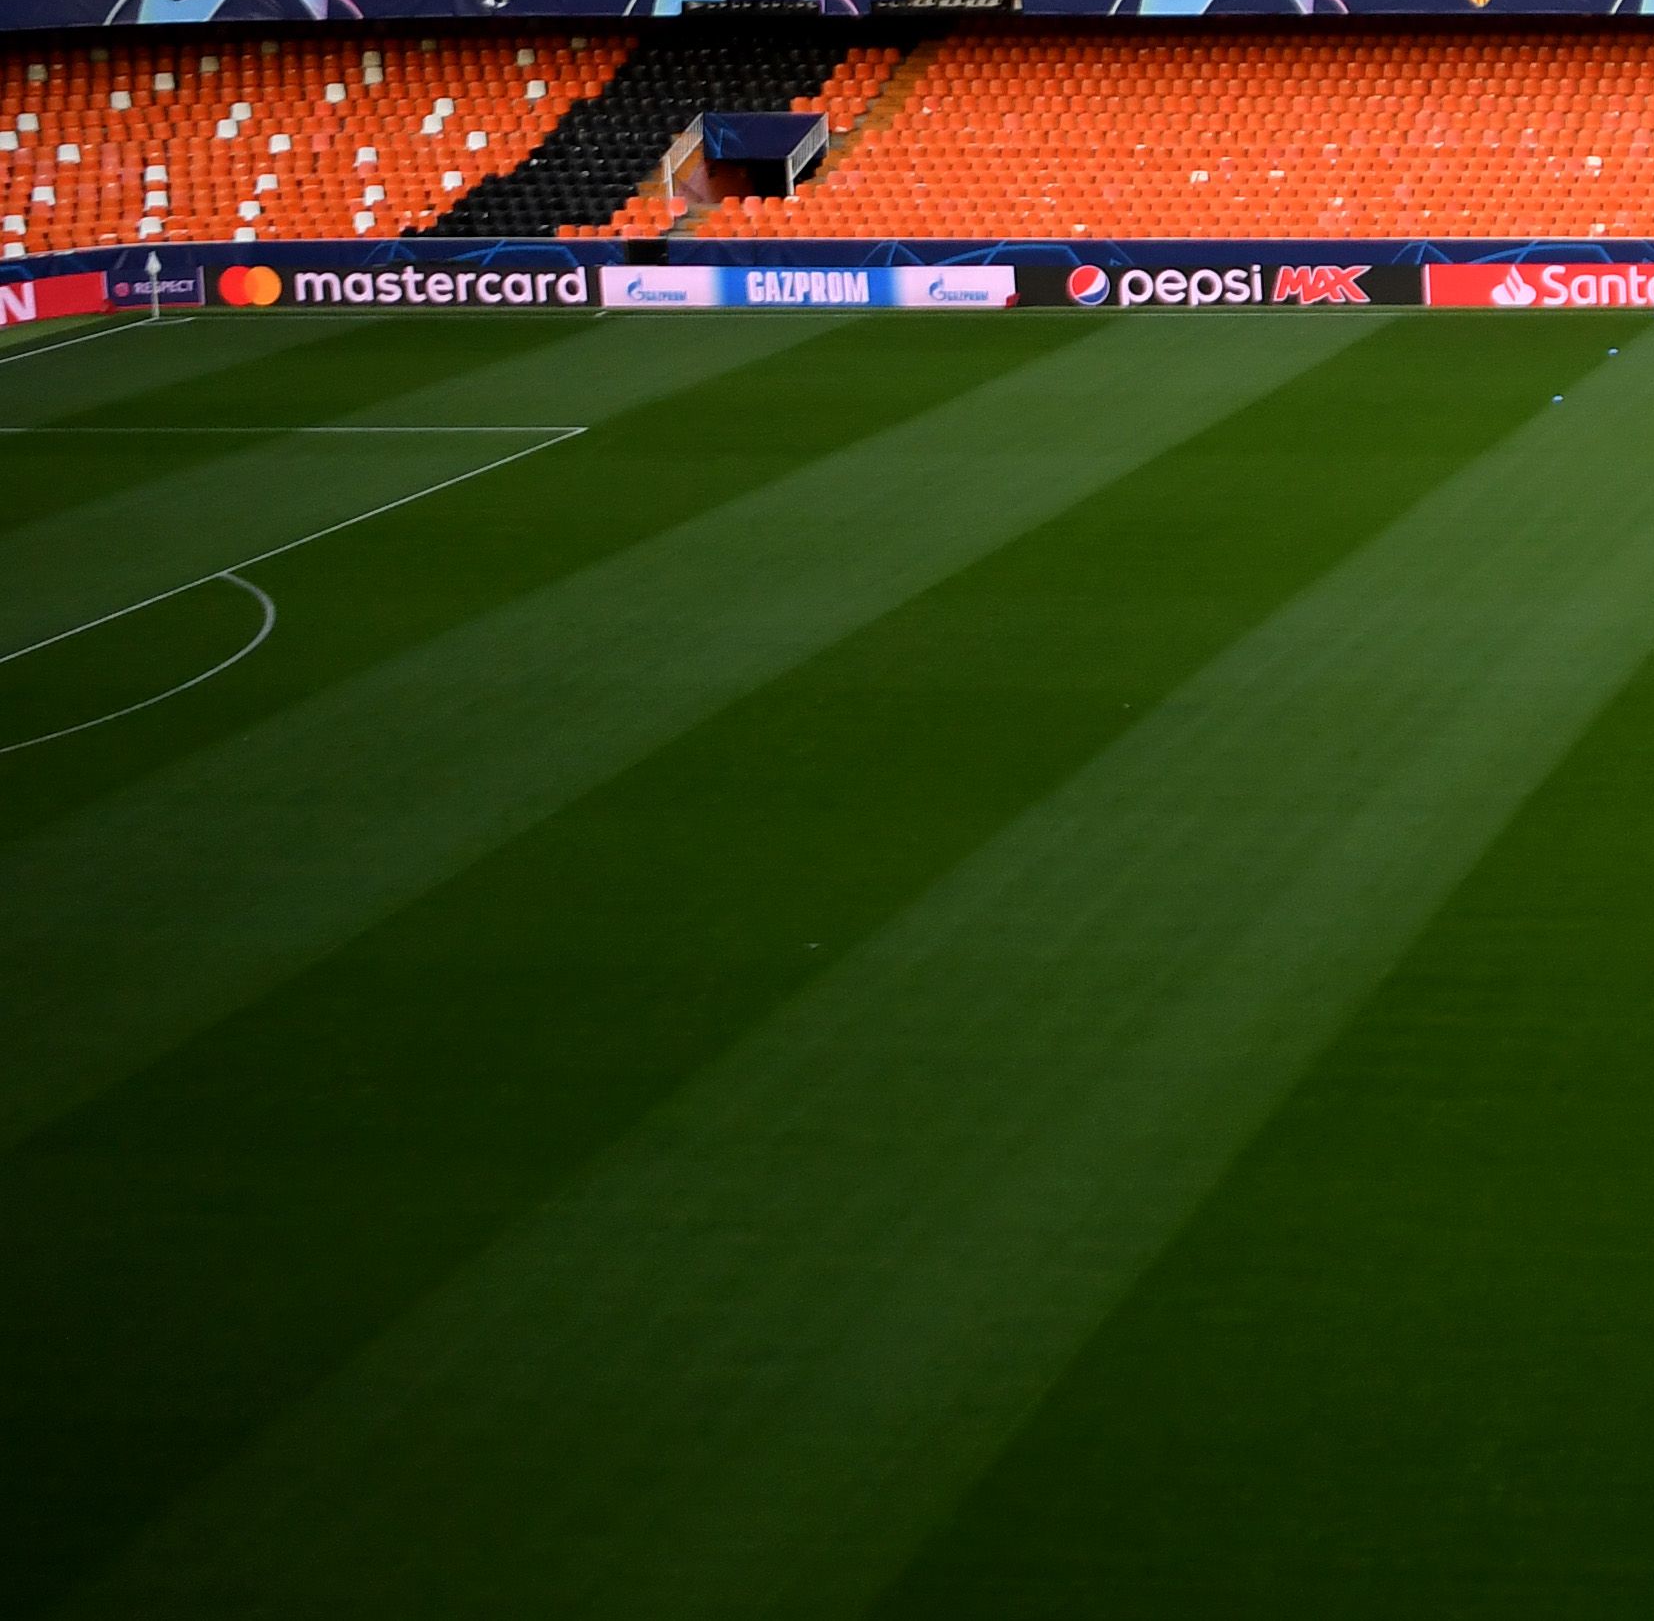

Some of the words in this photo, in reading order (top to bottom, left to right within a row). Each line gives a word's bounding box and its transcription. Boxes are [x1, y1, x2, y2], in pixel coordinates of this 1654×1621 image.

[294, 265, 587, 306] mastercard
[746, 270, 869, 305] GAZPROM
[1119, 264, 1263, 308] pepsi
[1272, 264, 1372, 305] MAX
